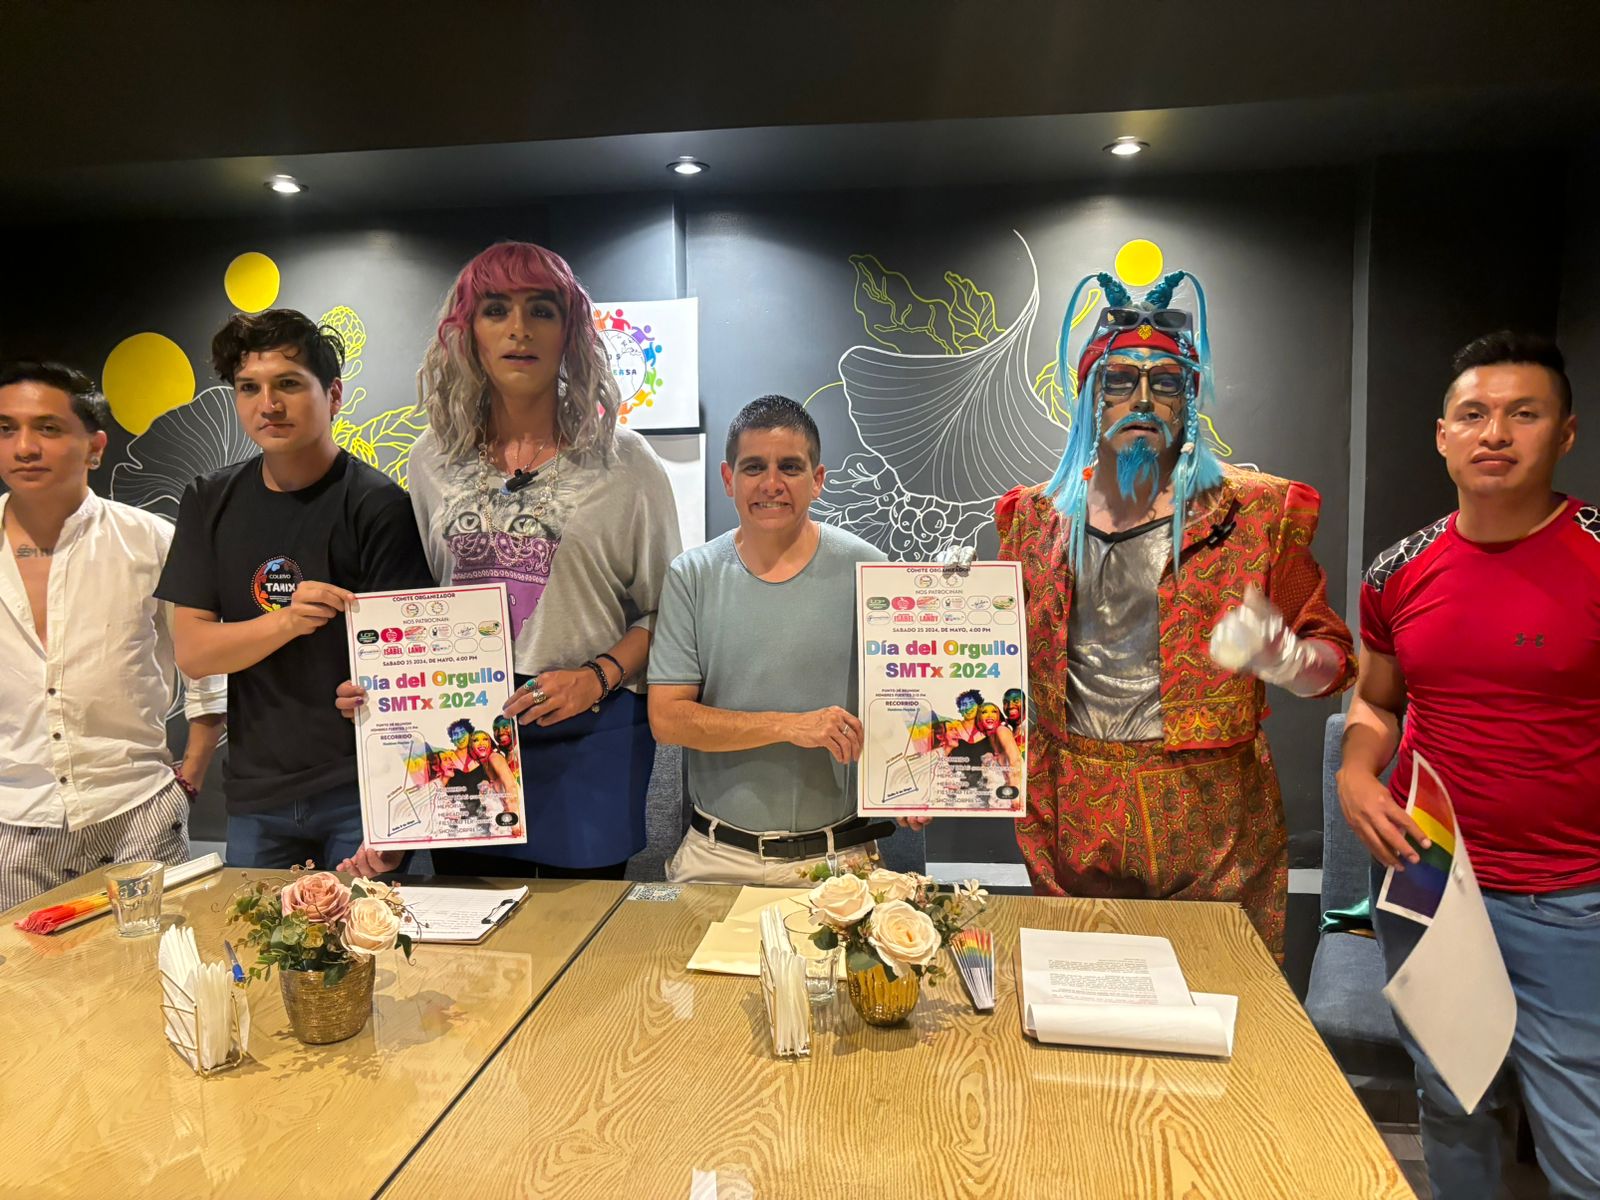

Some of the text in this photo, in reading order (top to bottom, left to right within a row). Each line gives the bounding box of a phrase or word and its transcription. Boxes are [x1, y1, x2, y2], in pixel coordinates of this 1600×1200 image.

[866, 640, 1019, 659] Día del Orgullo
[359, 667, 505, 691] Día del Orgullo
[885, 662, 1000, 678] SMTx 2024
[378, 690, 488, 712] SMTx 2024
